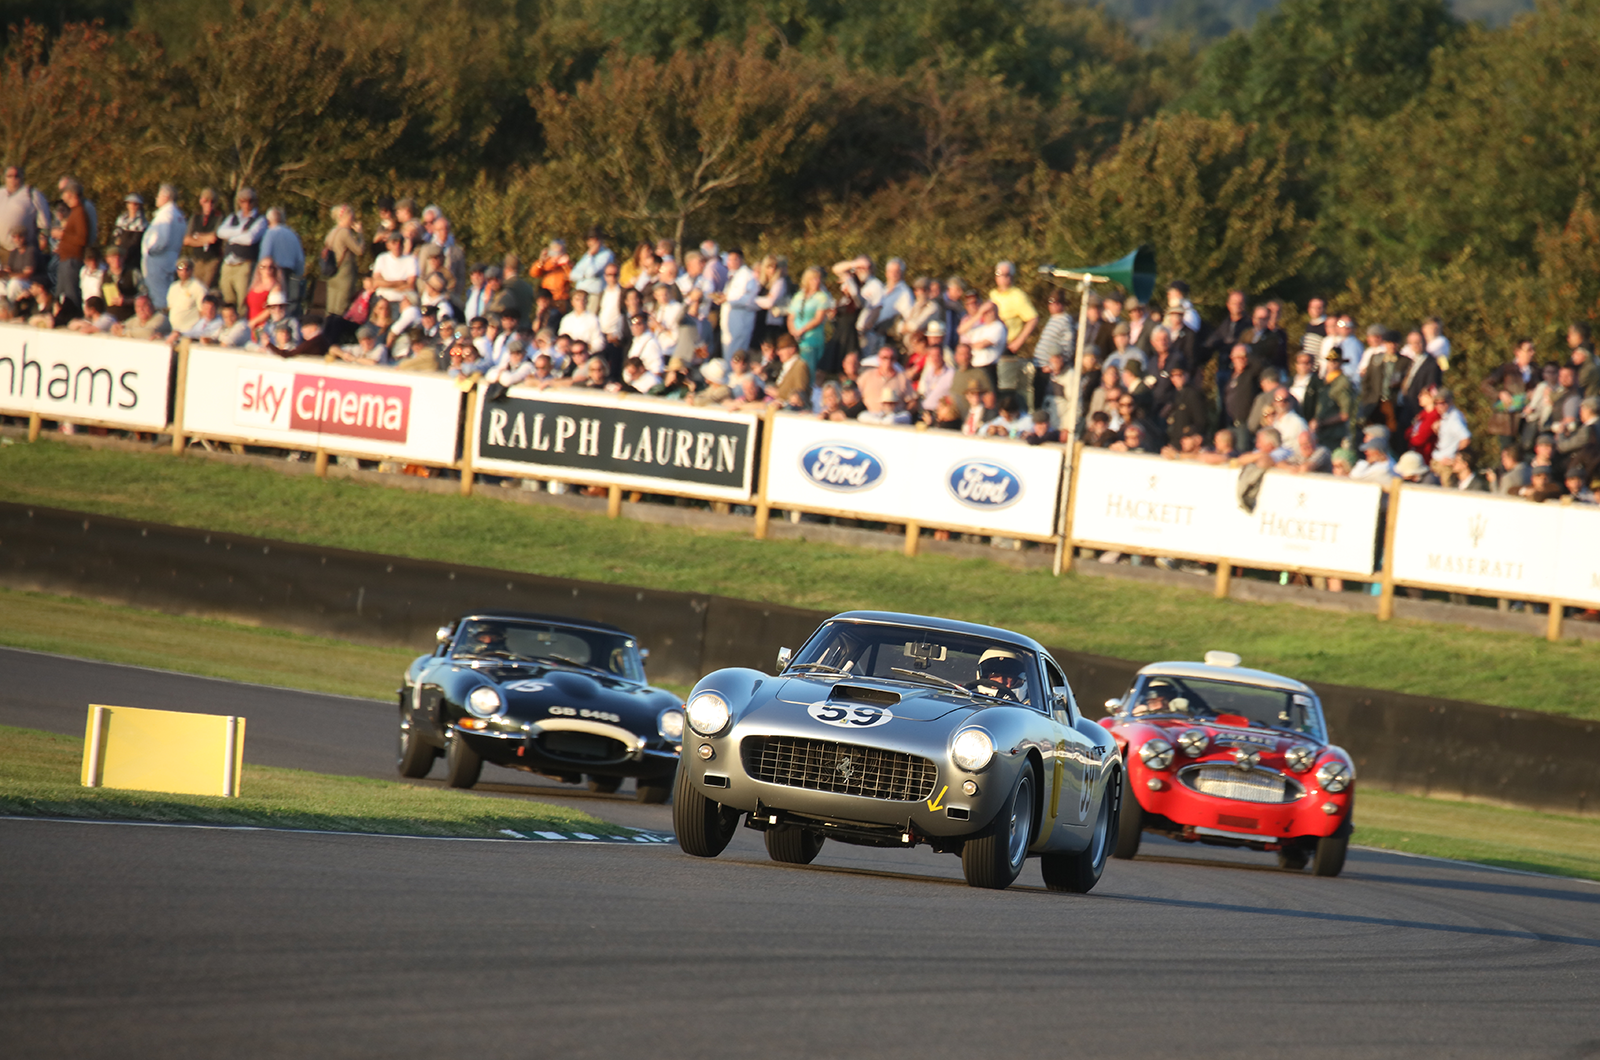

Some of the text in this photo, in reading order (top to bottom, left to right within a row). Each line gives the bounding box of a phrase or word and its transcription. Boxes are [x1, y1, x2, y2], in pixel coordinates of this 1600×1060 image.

[0, 342, 138, 410] nhams
[242, 374, 404, 431] sky cinema
[487, 408, 739, 473] RALPH LAUREN
[812, 446, 871, 486] Ford
[957, 463, 1011, 504] Ford
[1105, 492, 1196, 526] HACKETT
[1258, 510, 1342, 544] HACKETT
[1425, 552, 1525, 580] MASERATI
[816, 702, 884, 726] 59
